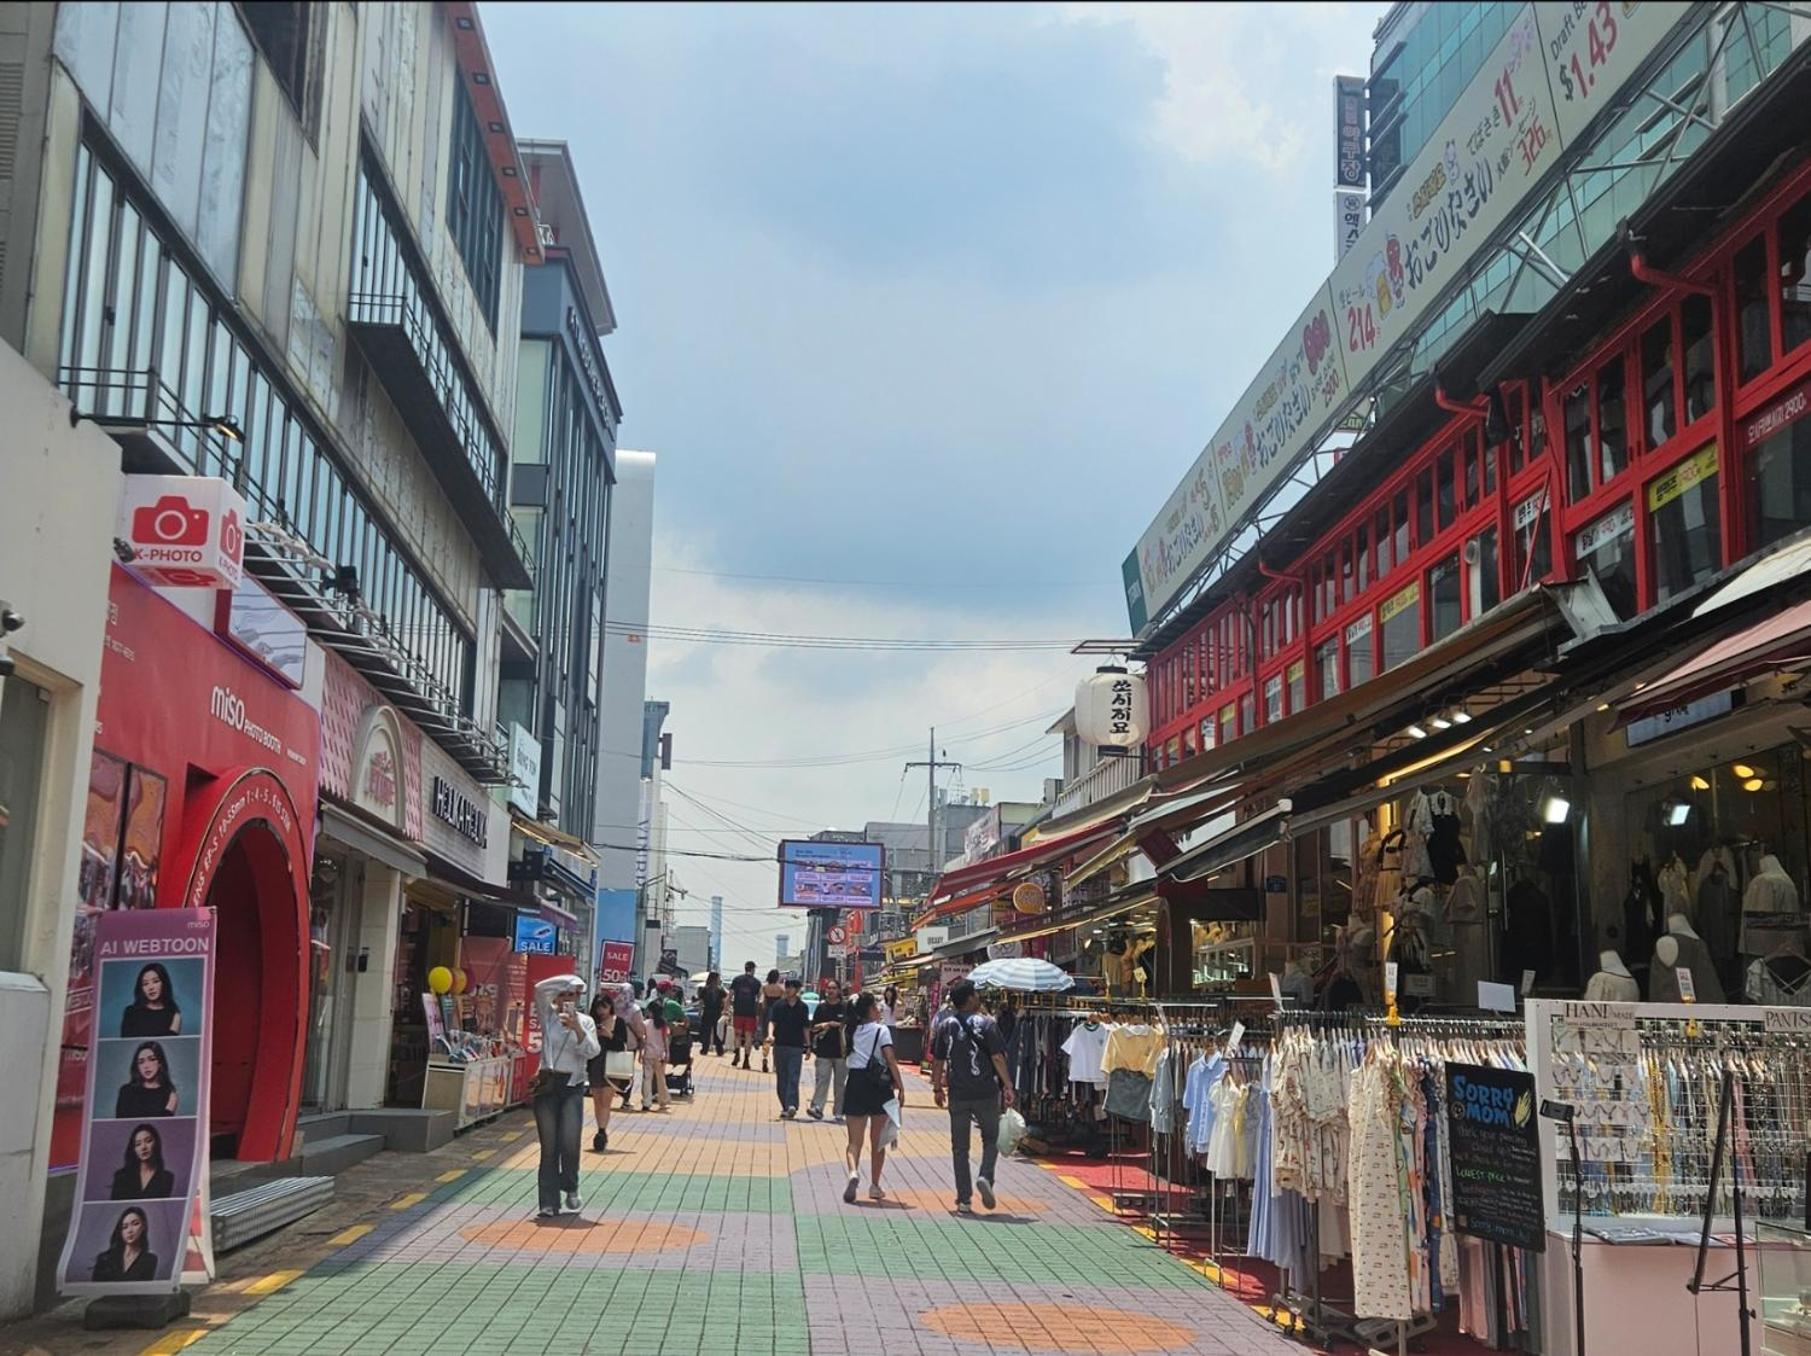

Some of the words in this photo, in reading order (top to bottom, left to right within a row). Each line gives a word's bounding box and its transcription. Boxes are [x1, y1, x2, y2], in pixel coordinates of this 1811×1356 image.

[1551, 13, 1575, 60] Draft
[134, 549, 203, 562] K-PHOTO
[211, 685, 245, 731] miso
[101, 940, 118, 955] AI
[123, 937, 209, 954] WEBTOON
[521, 942, 551, 952] SALE
[606, 952, 629, 961] SALE
[1466, 1104, 1510, 1128] MOM
